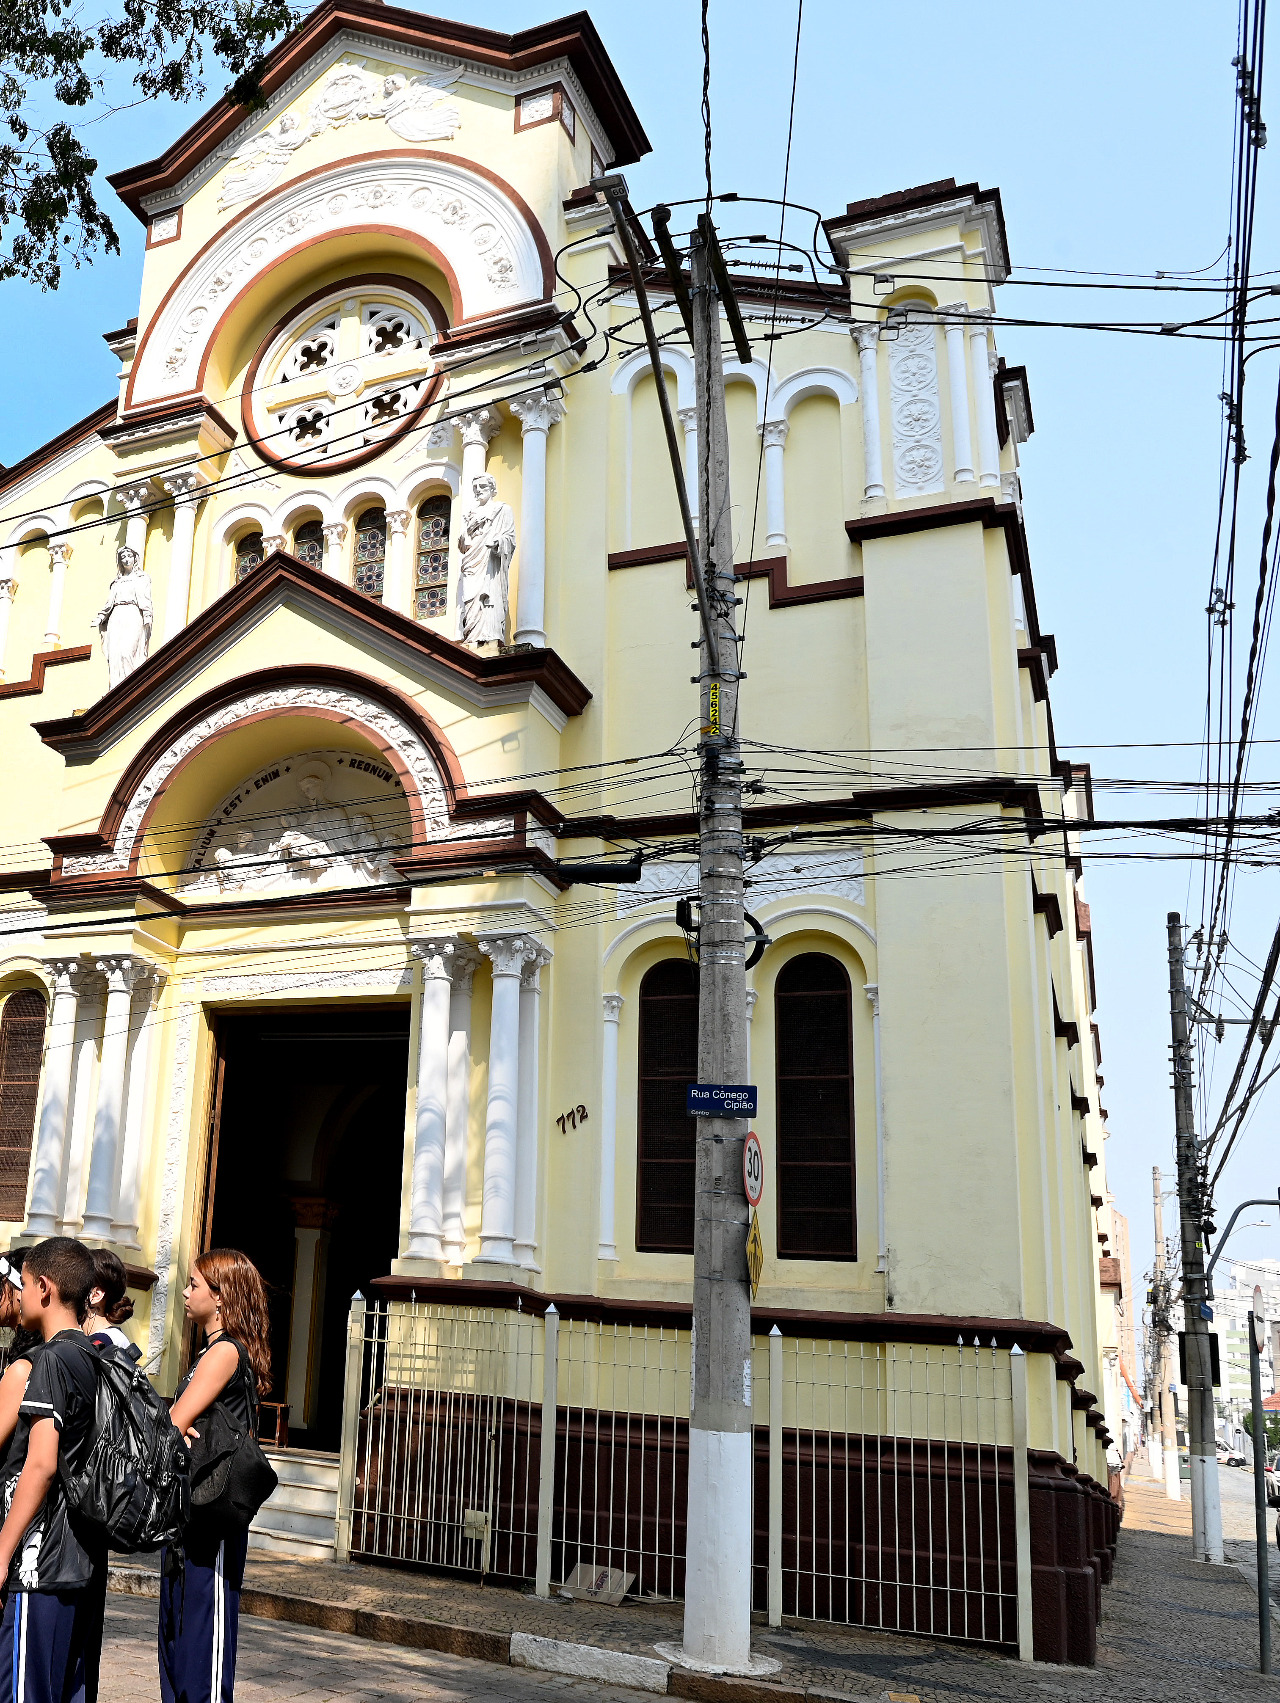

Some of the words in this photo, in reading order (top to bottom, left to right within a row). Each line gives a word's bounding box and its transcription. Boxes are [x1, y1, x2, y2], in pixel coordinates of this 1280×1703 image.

[710, 684, 720, 735] 456242
[223, 795, 243, 816] EST
[254, 769, 280, 790] ENIM
[691, 1089, 710, 1098] Rua
[712, 1090, 749, 1101] Cônego
[724, 1100, 754, 1110] Cipião
[556, 1104, 589, 1135] 772
[747, 1145, 760, 1182] 30
